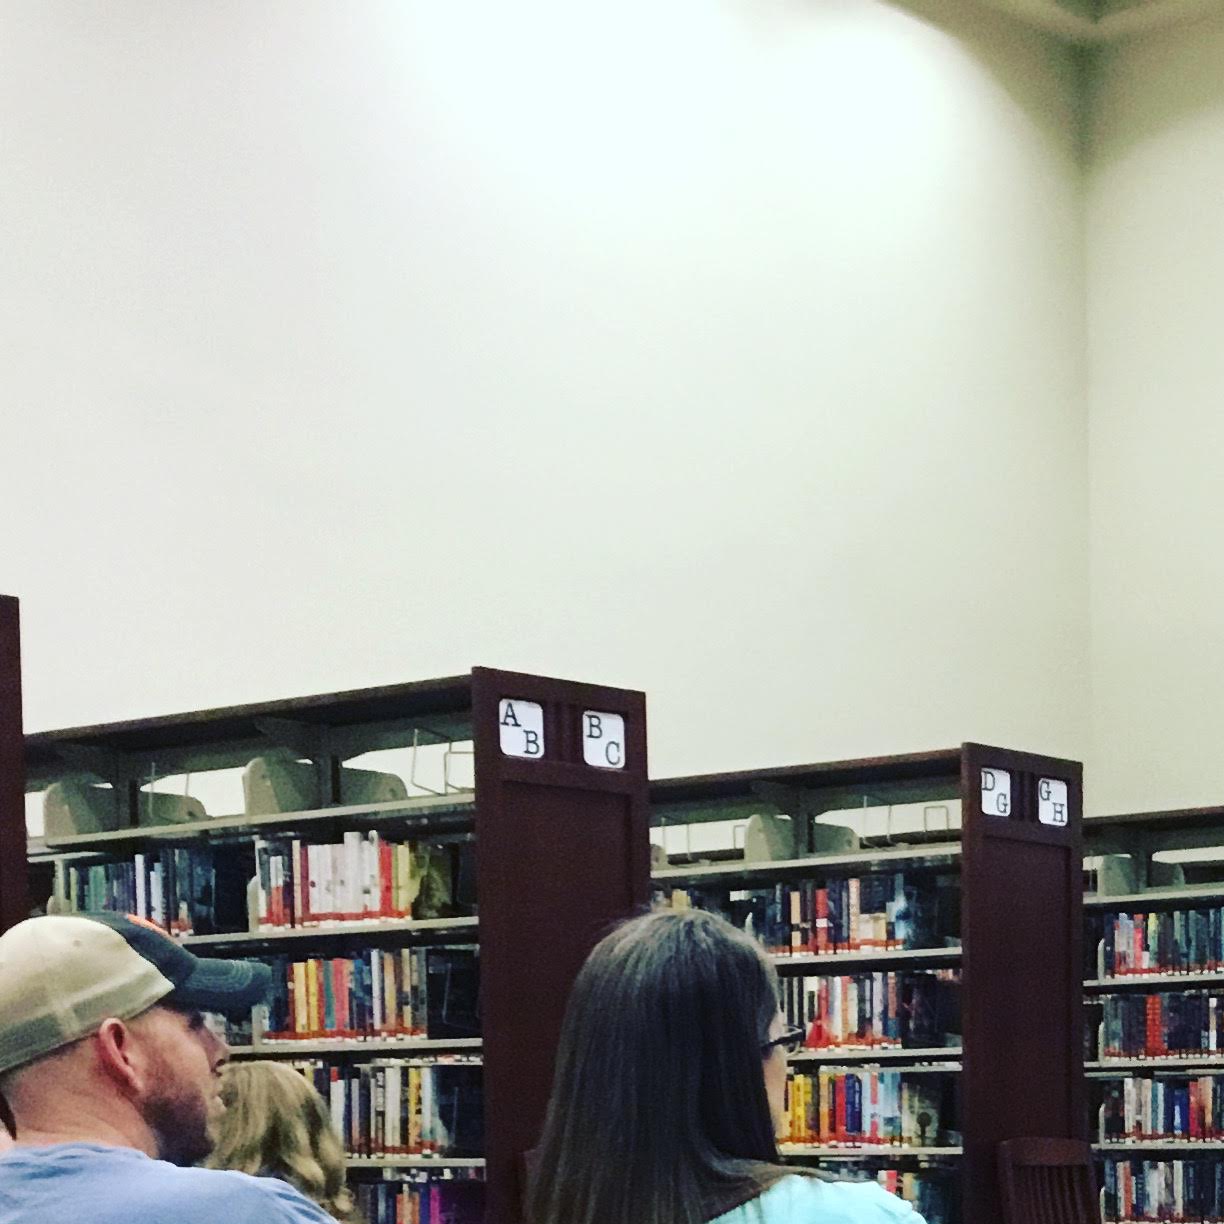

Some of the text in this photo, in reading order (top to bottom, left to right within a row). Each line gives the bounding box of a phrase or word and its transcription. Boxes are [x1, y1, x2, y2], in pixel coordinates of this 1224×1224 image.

[500, 702, 521, 727] A
[585, 714, 603, 738] B
[522, 729, 540, 755] B
[605, 741, 620, 765] C
[981, 770, 996, 791] D
[1039, 780, 1052, 801] G
[996, 792, 1008, 813] G
[1052, 802, 1065, 822] H
